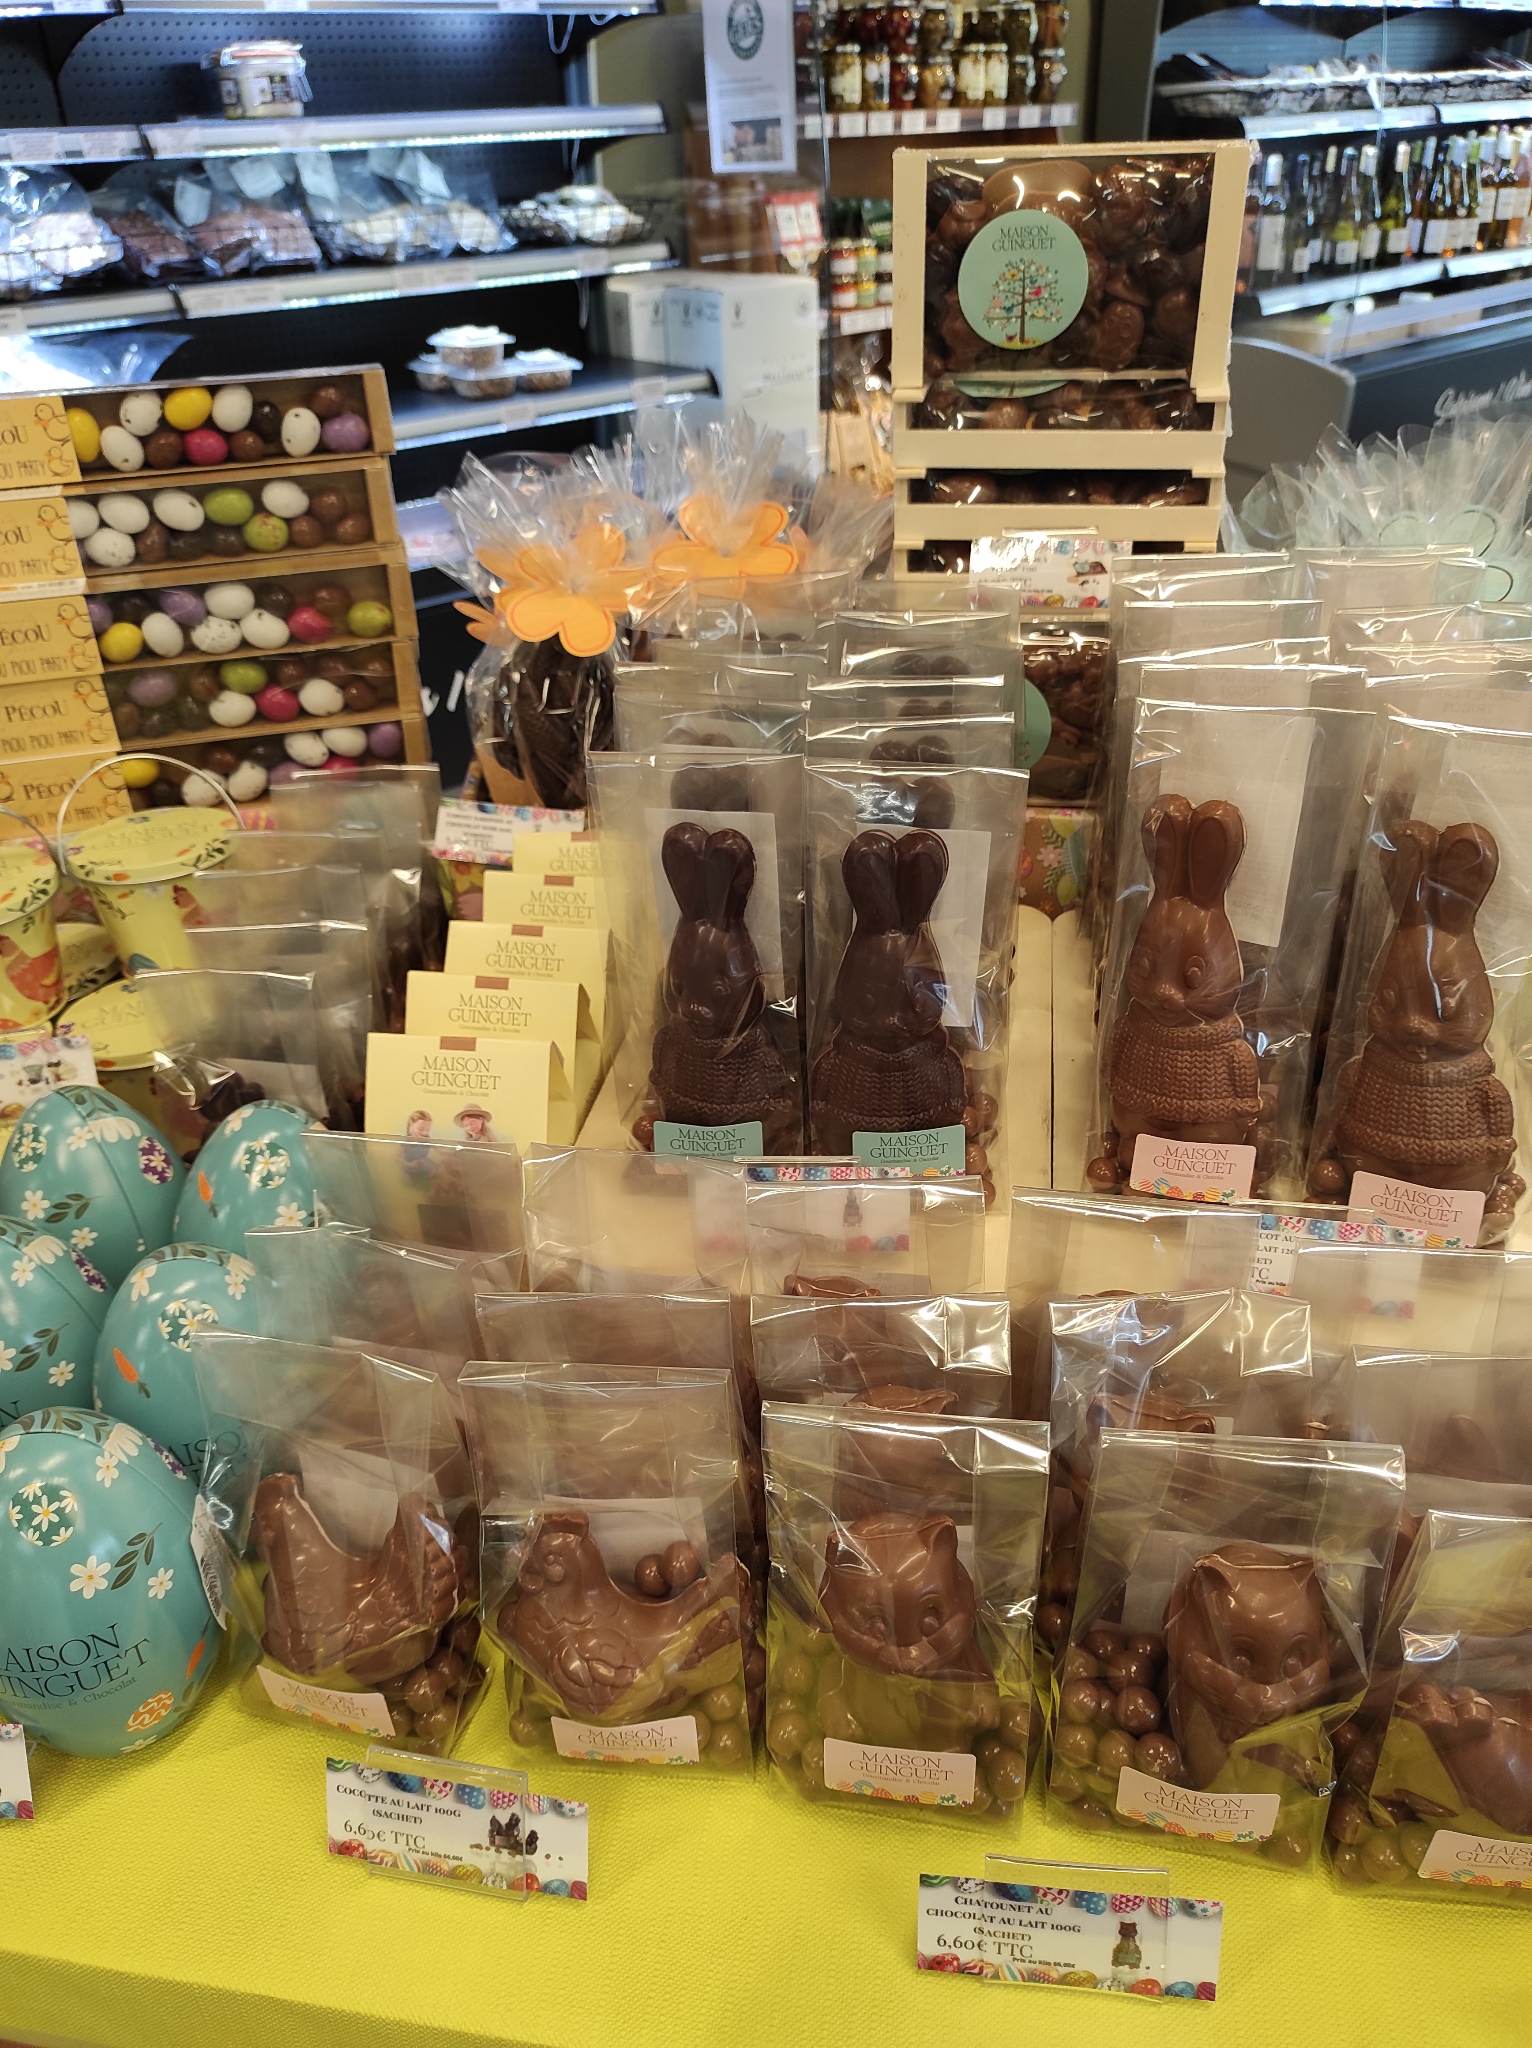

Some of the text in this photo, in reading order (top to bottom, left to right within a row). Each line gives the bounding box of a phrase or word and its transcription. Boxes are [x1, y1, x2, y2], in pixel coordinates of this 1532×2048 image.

[1000, 224, 1049, 240] MAISON
[991, 237, 1056, 253] GUINGUET
[0, 426, 29, 446] OU
[529, 890, 587, 905] MAISON
[519, 903, 595, 920] GUINGUET
[496, 940, 556, 956] MAISON
[485, 954, 565, 973] GUINGUET
[458, 993, 525, 1010] MAISON
[448, 1008, 532, 1028] GUINGUET
[422, 1055, 492, 1074] MAISON
[411, 1071, 502, 1091] GUINGUET
[678, 1128, 737, 1141] MAISON
[879, 1132, 940, 1148] MAISON
[669, 1138, 747, 1153] GUINGUET
[869, 1142, 949, 1159] GUINGUET
[1163, 1144, 1231, 1161] MAISON
[1153, 1155, 1237, 1175] GUINGUET
[1383, 1183, 1455, 1209] MAISON
[1370, 1194, 1463, 1223] GUINGUET
[1258, 1232, 1281, 1241] COT
[1253, 1256, 1273, 1265] ET)
[1251, 1265, 1270, 1280] TC
[3, 1622, 119, 1673] AISON
[83, 1677, 137, 1703] Chocolat
[578, 1734, 678, 1749] GUINGUET
[588, 1725, 665, 1740] MAISON
[861, 1750, 942, 1770] MAISON
[849, 1759, 954, 1781] GUINGUET
[336, 1783, 462, 1819] COCOTTE AU LAIT 100G
[1143, 1791, 1256, 1821] GUINGUET
[1159, 1785, 1244, 1810] MAISON
[372, 1808, 424, 1826] (SACHET)
[390, 1829, 427, 1850] TTC
[1473, 1842, 1532, 1857] MAIS
[954, 1895, 1053, 1916] CHATOUNET AU
[926, 1907, 1082, 1934] CHOCOLAT AU LAIT 100G
[973, 1926, 1033, 1943] (SACHET)
[936, 1933, 1033, 1960] 6,60€ TTC
